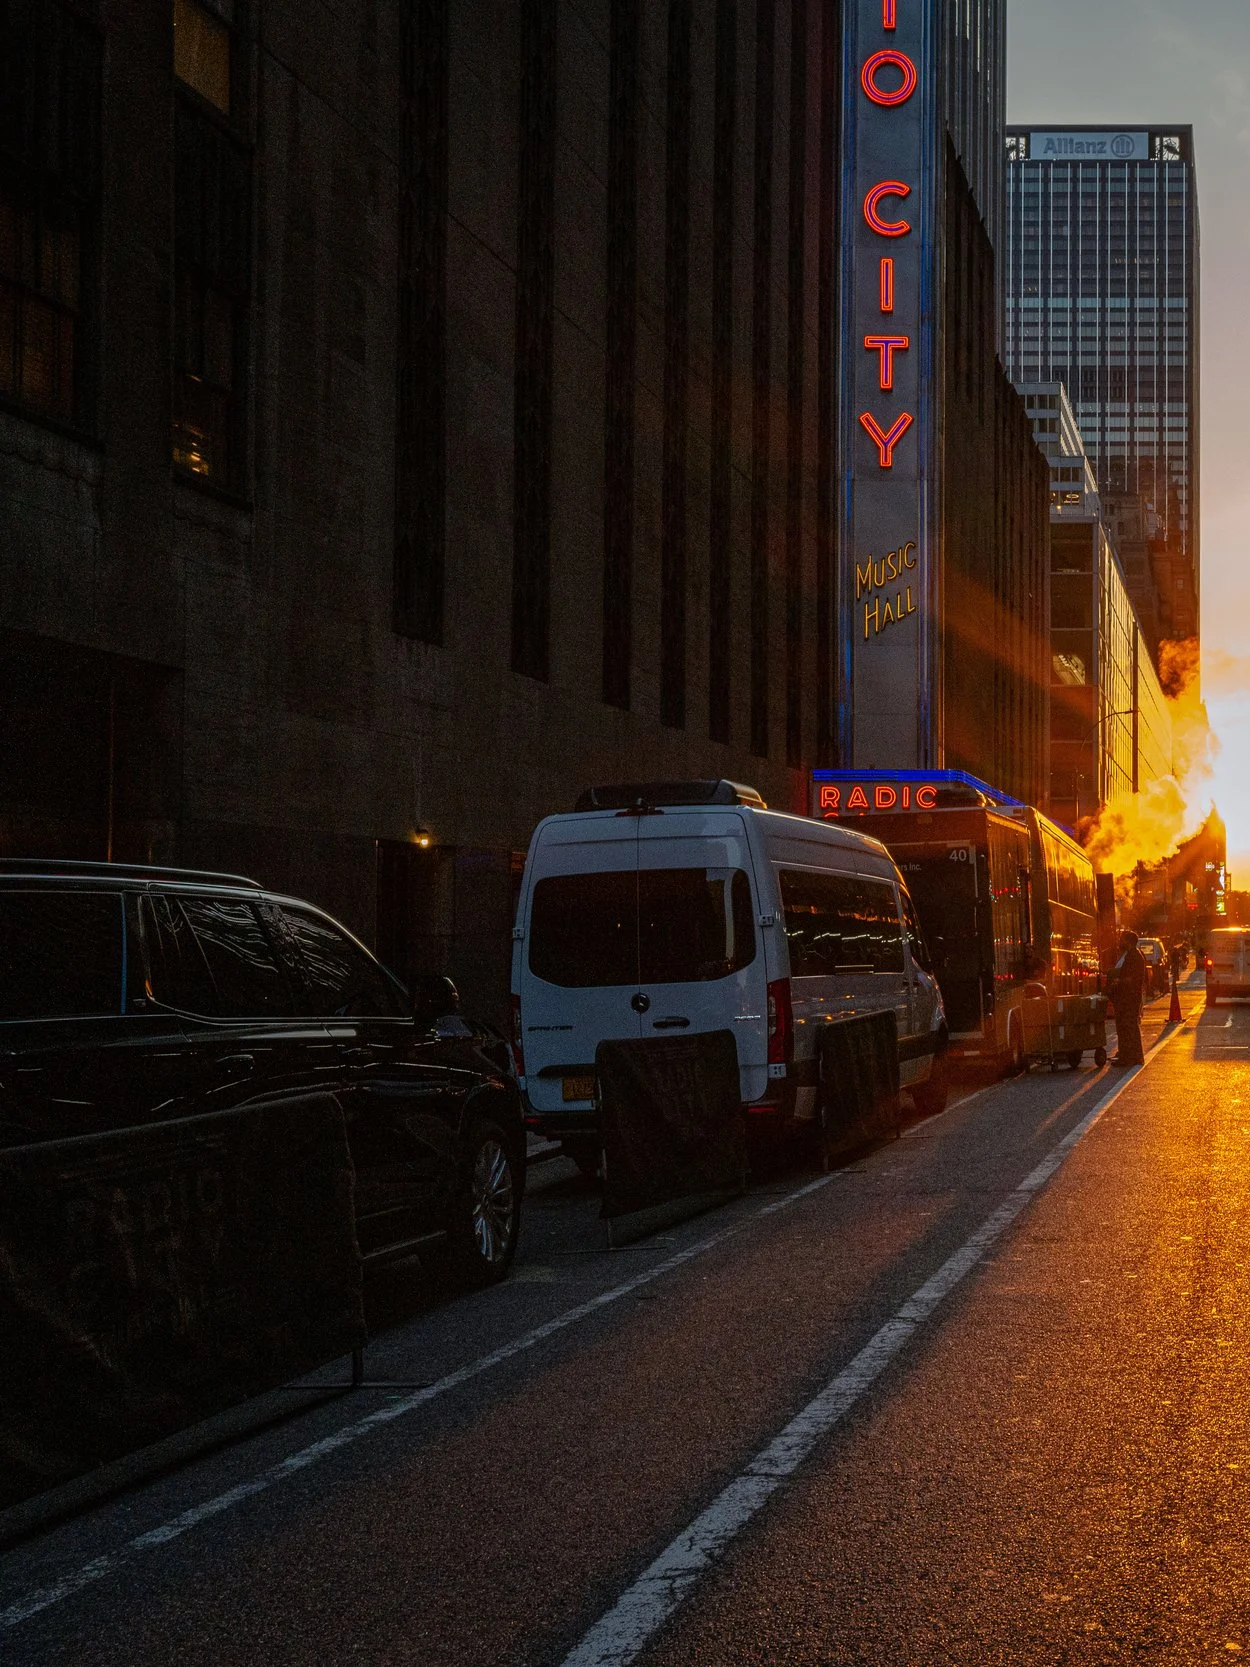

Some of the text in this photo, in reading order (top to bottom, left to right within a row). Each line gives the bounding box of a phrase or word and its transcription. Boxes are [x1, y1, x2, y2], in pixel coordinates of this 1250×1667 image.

[1043, 136, 1108, 154] Allianz
[860, 180, 914, 469] CITY
[856, 541, 917, 601] MUSIC
[864, 586, 917, 641] HALL
[949, 849, 968, 862] 40
